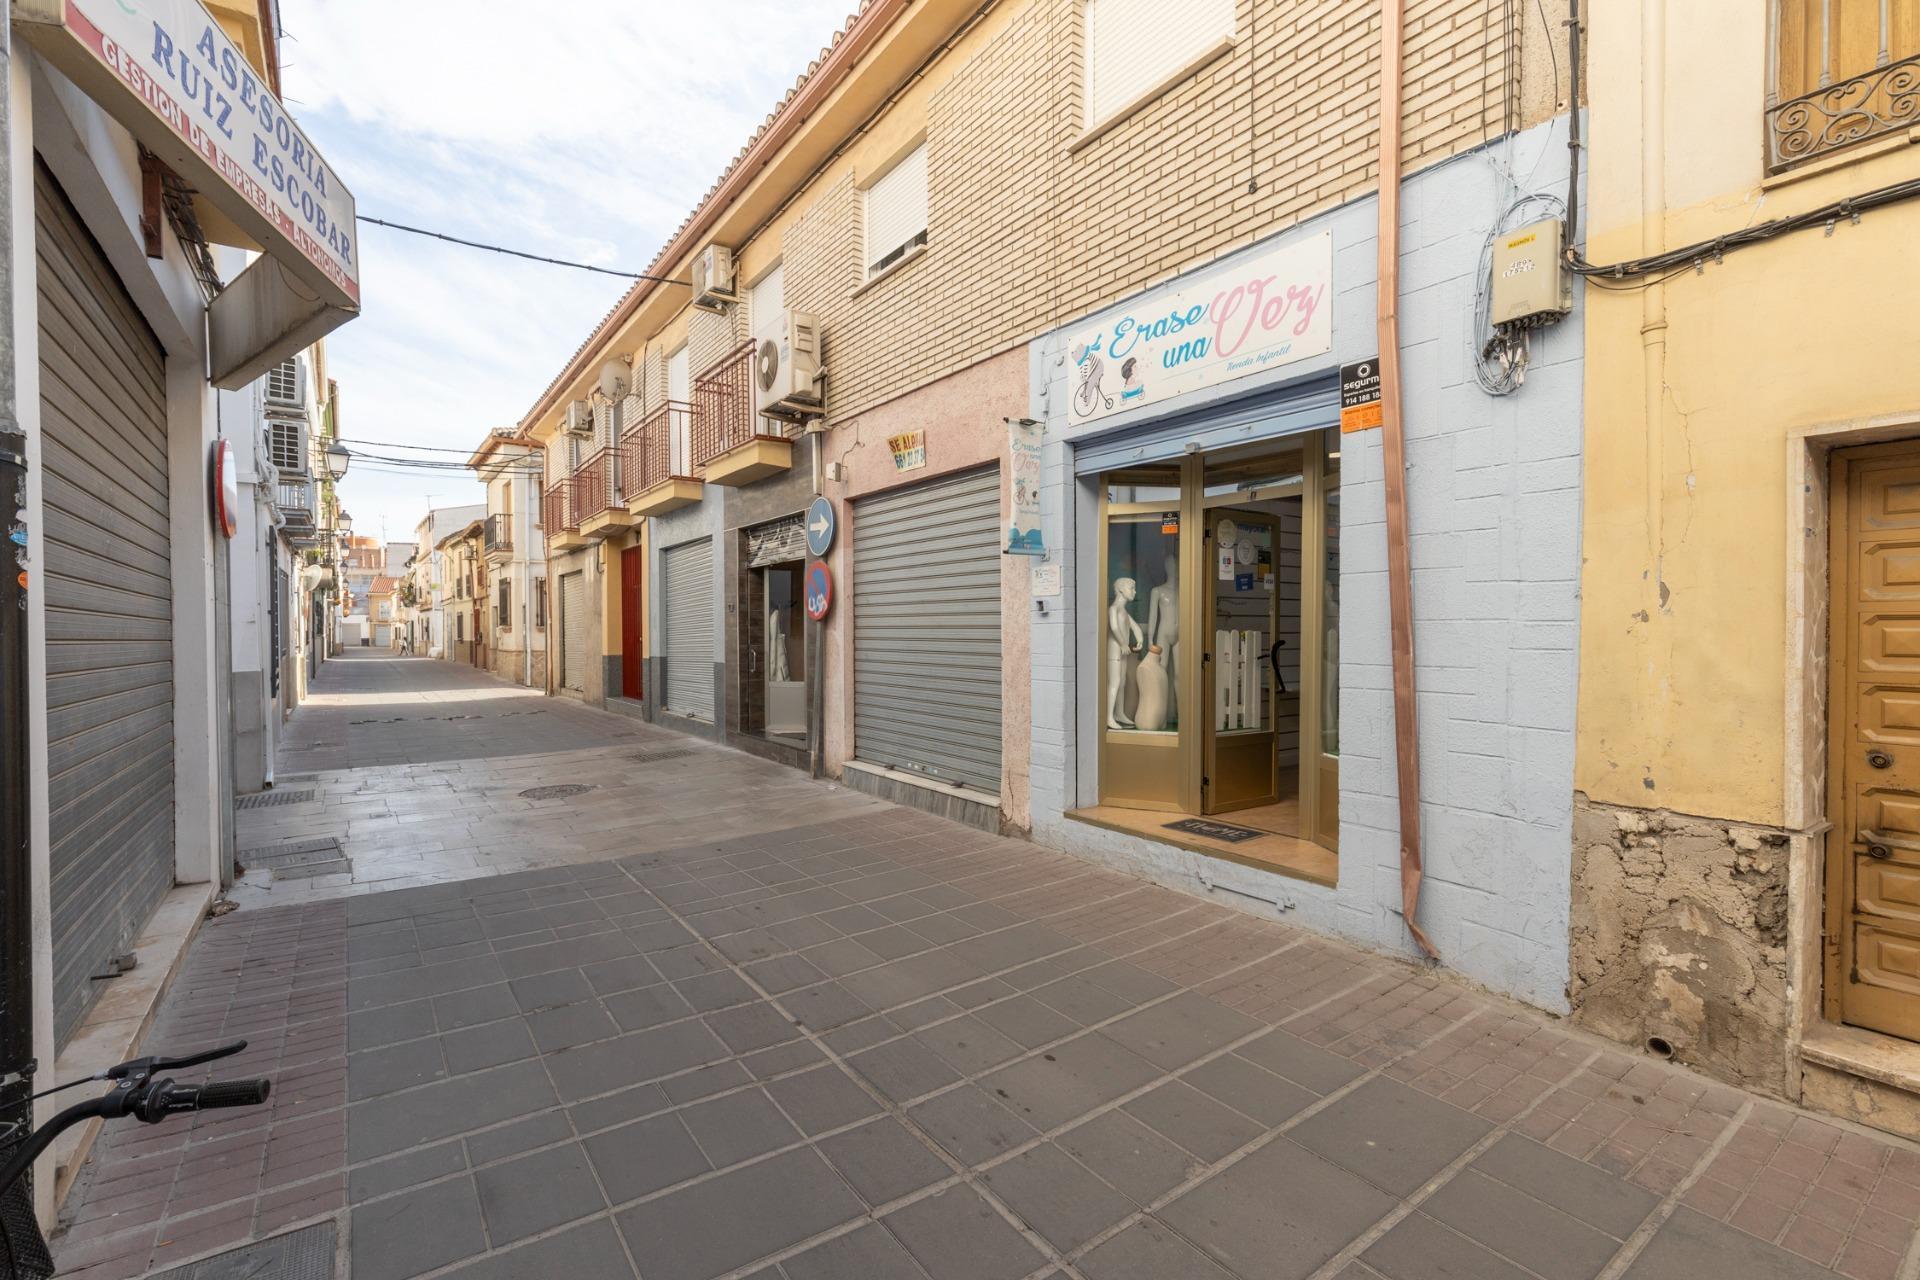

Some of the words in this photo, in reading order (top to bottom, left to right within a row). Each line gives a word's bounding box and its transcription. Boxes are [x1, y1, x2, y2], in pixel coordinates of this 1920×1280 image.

[101, 34, 183, 134] GESTION
[188, 119, 211, 160] DE
[214, 147, 282, 225] EMPRESAS
[151, 20, 234, 141] RUIZ
[252, 133, 352, 265] ESCOBAR
[196, 25, 328, 199] ASESORIA
[1109, 303, 1209, 359] Erase
[1163, 337, 1212, 368] una
[1210, 275, 1324, 358] Vez
[1343, 375, 1380, 391] segurm
[1372, 391, 1381, 399] 18
